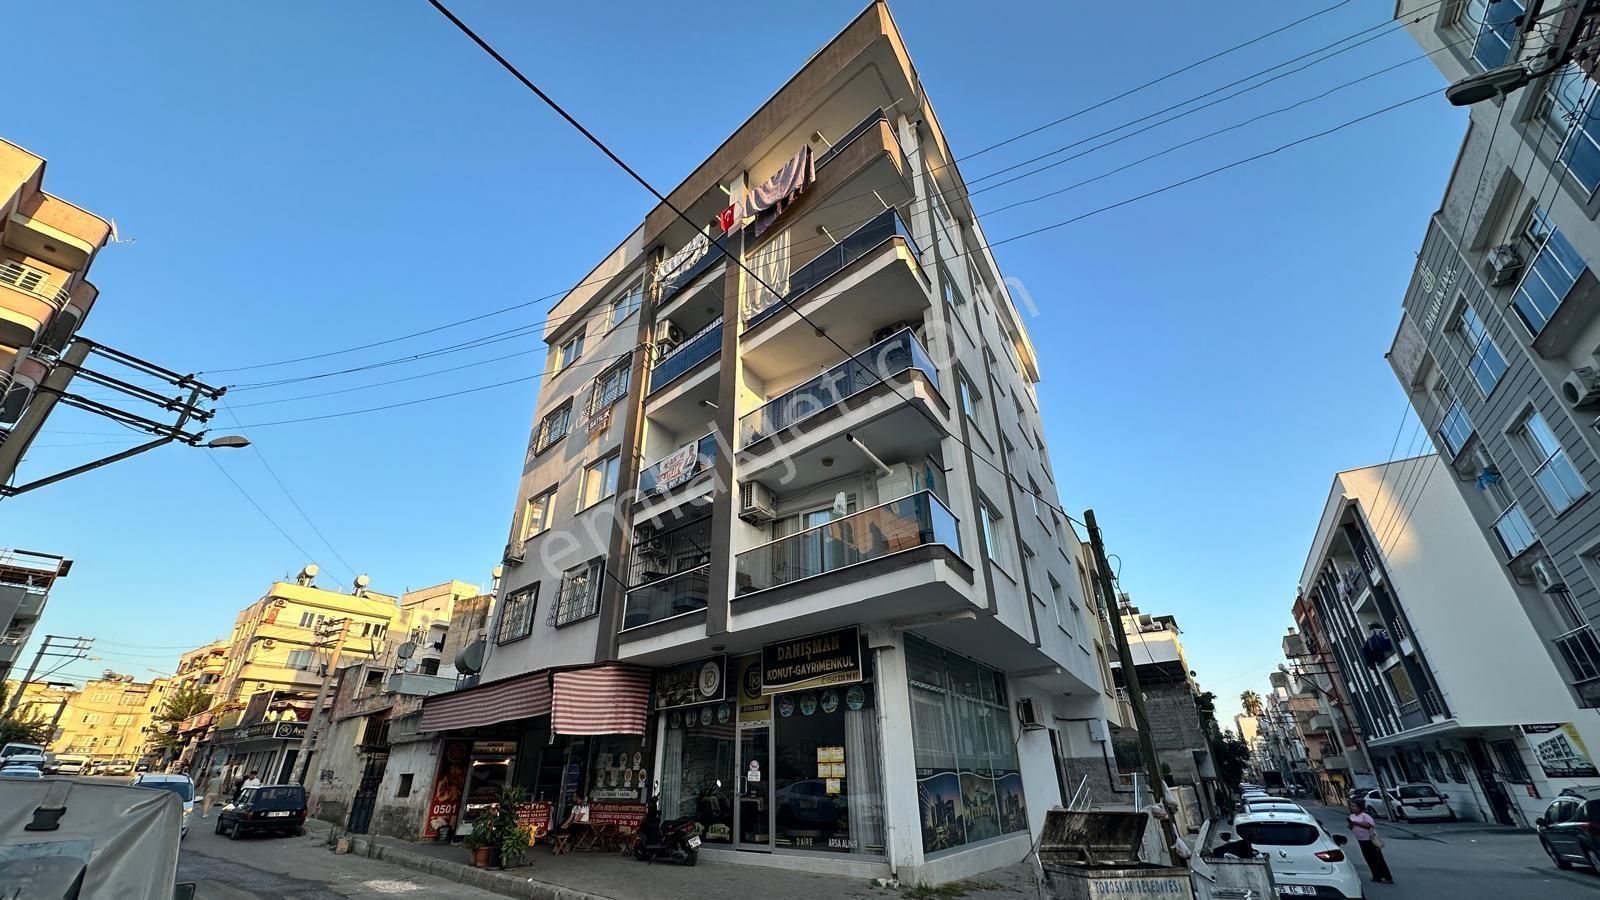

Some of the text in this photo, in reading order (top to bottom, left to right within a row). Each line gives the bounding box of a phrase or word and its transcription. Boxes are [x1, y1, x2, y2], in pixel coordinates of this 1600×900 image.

[776, 635, 840, 661] DANIŞMAN
[766, 656, 855, 681] KONUT-GAYRİMENKUL
[433, 804, 457, 815] 0501
[1094, 880, 1135, 894] TOROSLAR
